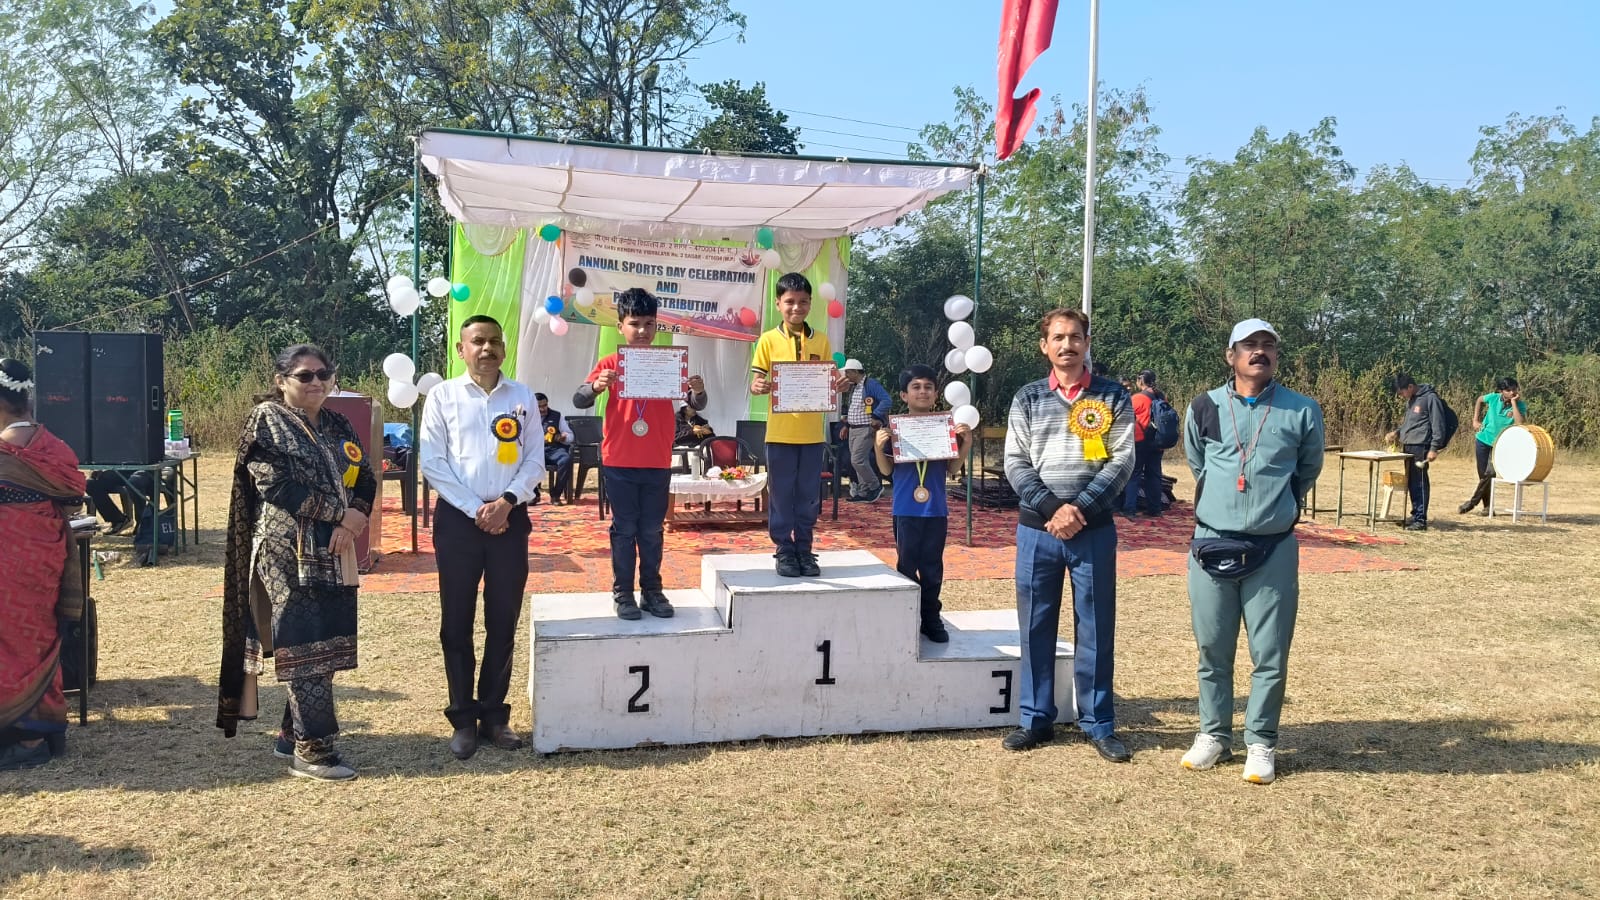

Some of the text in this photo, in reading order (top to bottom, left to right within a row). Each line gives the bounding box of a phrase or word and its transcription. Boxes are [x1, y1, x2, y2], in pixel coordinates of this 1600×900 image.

[579, 255, 755, 283] ANNUAL SPORTS DAY CELEBRATION
[656, 281, 677, 293] AND
[656, 297, 717, 312] STRIBUTION
[815, 639, 836, 685] 1
[627, 665, 650, 713] 2
[989, 669, 1013, 714] 3
